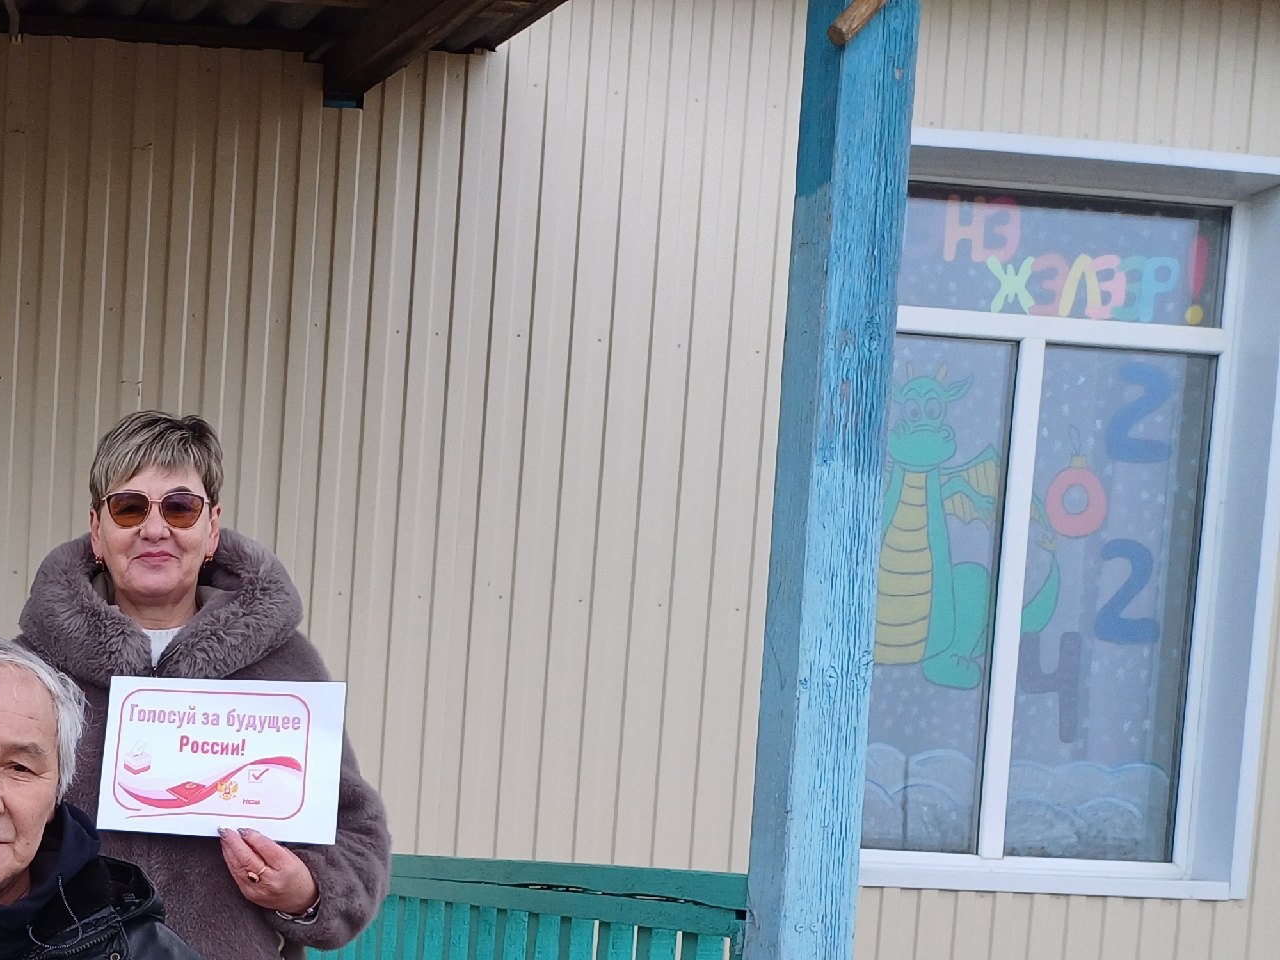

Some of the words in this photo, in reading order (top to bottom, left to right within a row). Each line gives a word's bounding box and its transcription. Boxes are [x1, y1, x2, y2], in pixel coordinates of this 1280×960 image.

[129, 703, 196, 728] Голосуй
[201, 711, 220, 726] за
[227, 709, 301, 733] будущее
[179, 735, 246, 756] России!
